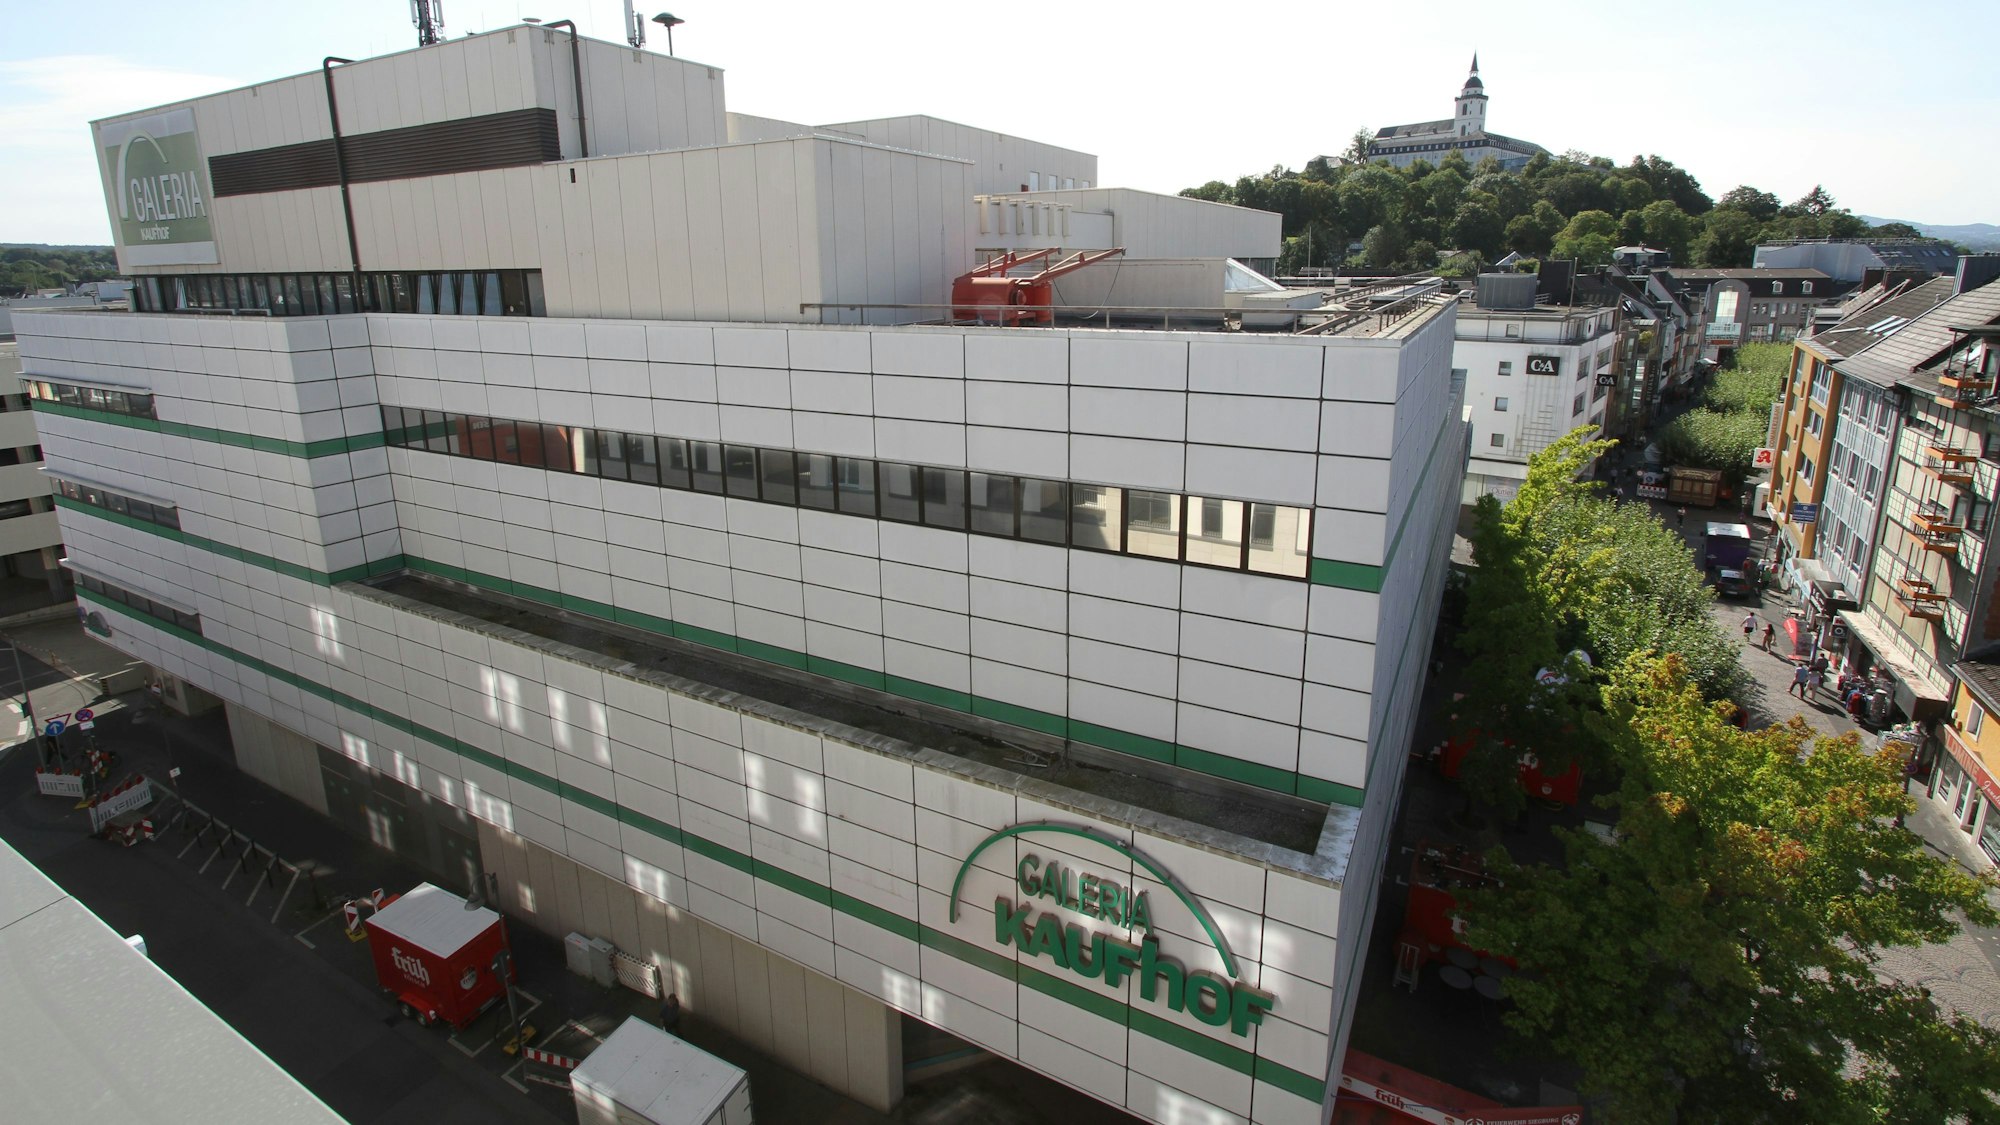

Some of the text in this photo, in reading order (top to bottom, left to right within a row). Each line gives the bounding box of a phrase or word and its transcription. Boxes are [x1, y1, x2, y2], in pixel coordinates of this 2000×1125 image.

[130, 170, 207, 222] GALERIA
[1530, 359, 1555, 373] C&A
[1599, 376, 1615, 385] C&A
[1018, 854, 1153, 935] GALERIA
[1528, 1117, 1559, 1125] SIEGBURG
